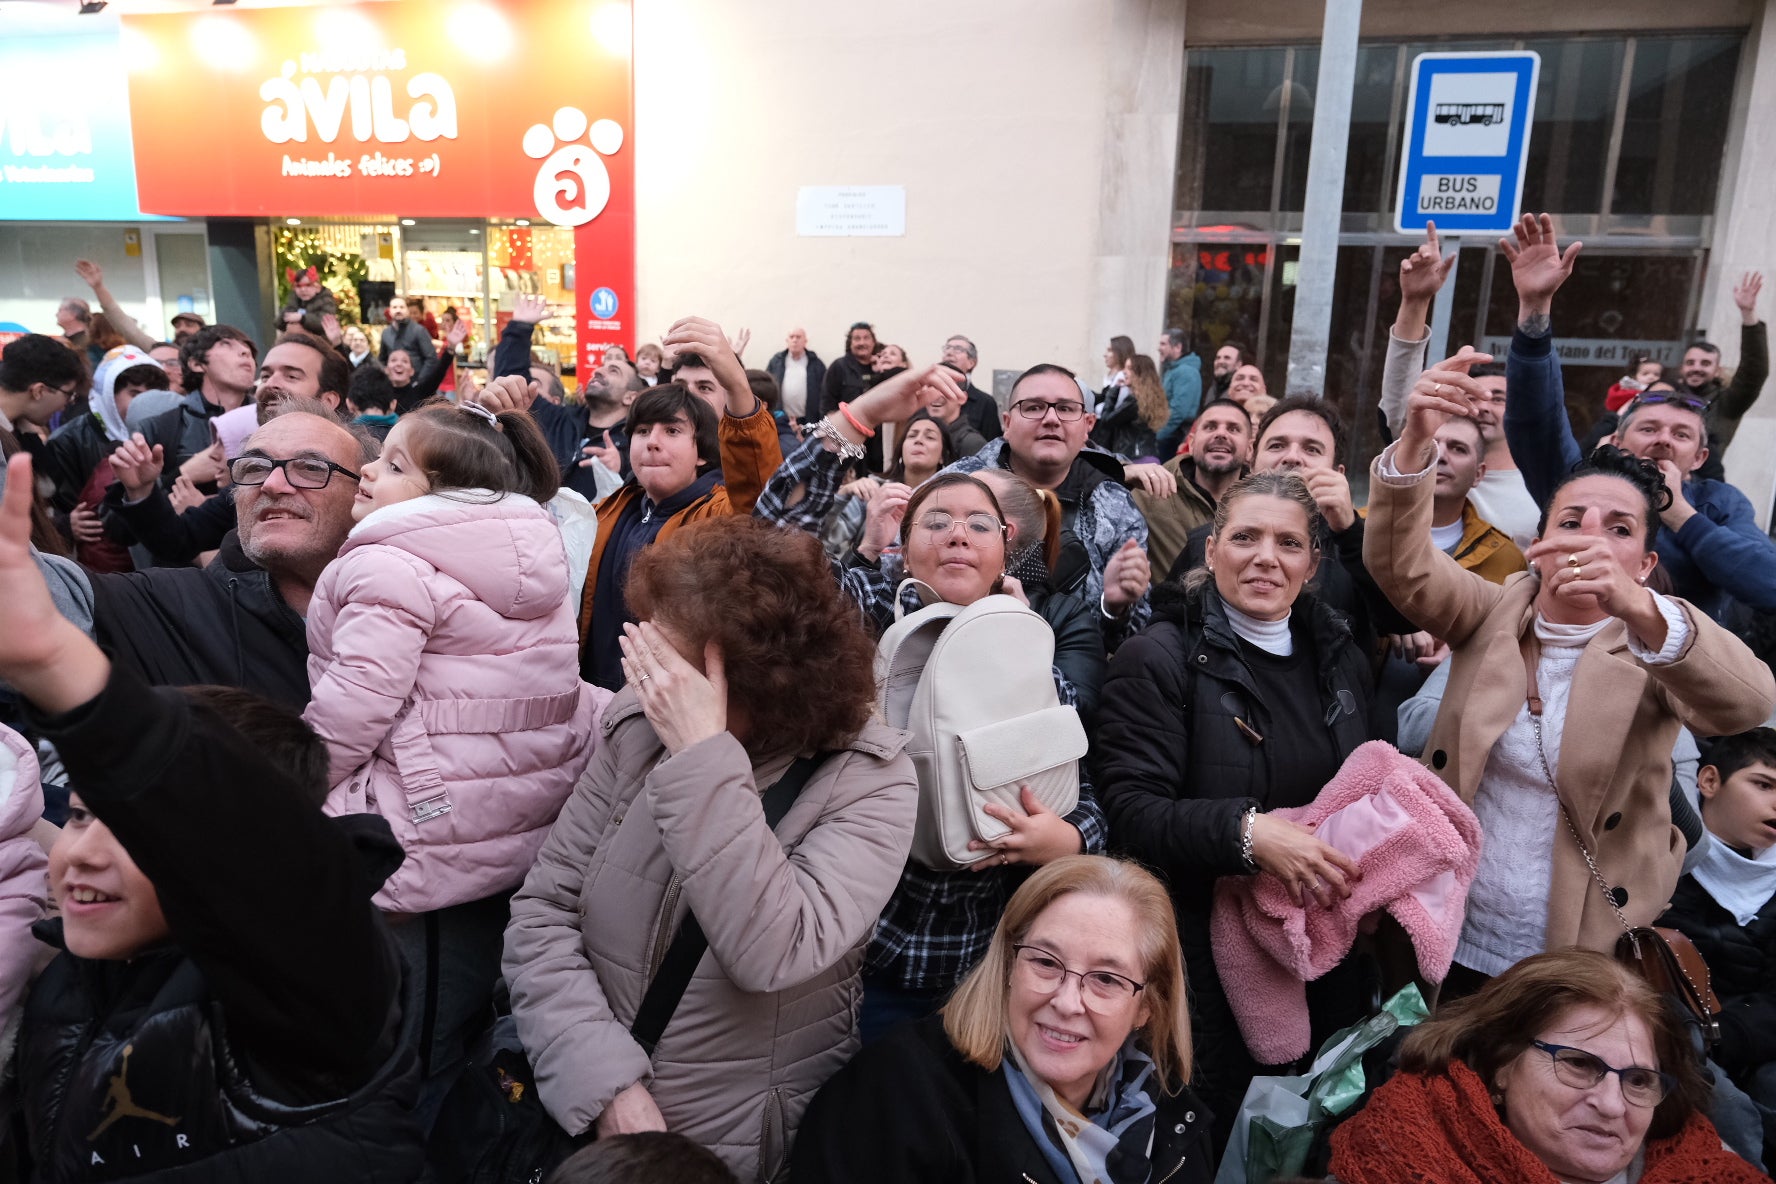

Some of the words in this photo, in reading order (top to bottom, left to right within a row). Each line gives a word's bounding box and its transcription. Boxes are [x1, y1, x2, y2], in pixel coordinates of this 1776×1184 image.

[281, 152, 352, 178] Animales
[358, 151, 414, 177] felices
[1438, 177, 1478, 193] BUS
[1420, 196, 1495, 211] URBANO
[1595, 345, 1617, 360] del
[1655, 347, 1673, 362] 17
[91, 1133, 190, 1165] AIR
